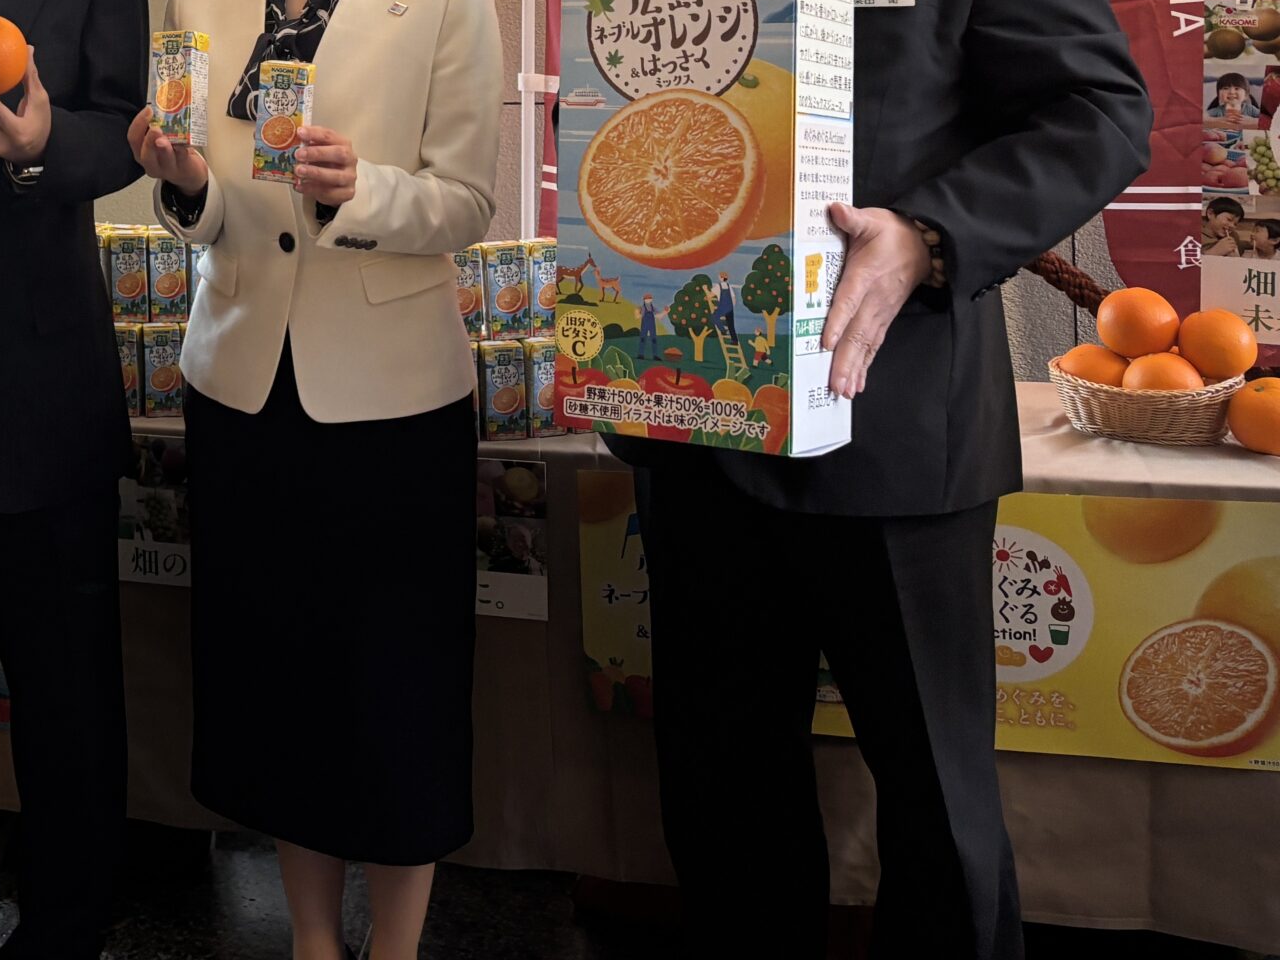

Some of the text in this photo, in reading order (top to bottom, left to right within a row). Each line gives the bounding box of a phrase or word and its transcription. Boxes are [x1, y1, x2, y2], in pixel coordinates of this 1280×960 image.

[1220, 18, 1257, 26] KAGOME
[656, 74, 694, 88] ミックス
[1241, 304, 1280, 332] 未
[561, 326, 598, 340] ビタミン
[572, 340, 585, 357] C
[568, 400, 769, 437] 砂糖不使用 イラストは味のイメージです
[998, 575, 1041, 599] ぐみ
[998, 600, 1038, 625] ぐる
[993, 628, 1037, 641] ction!
